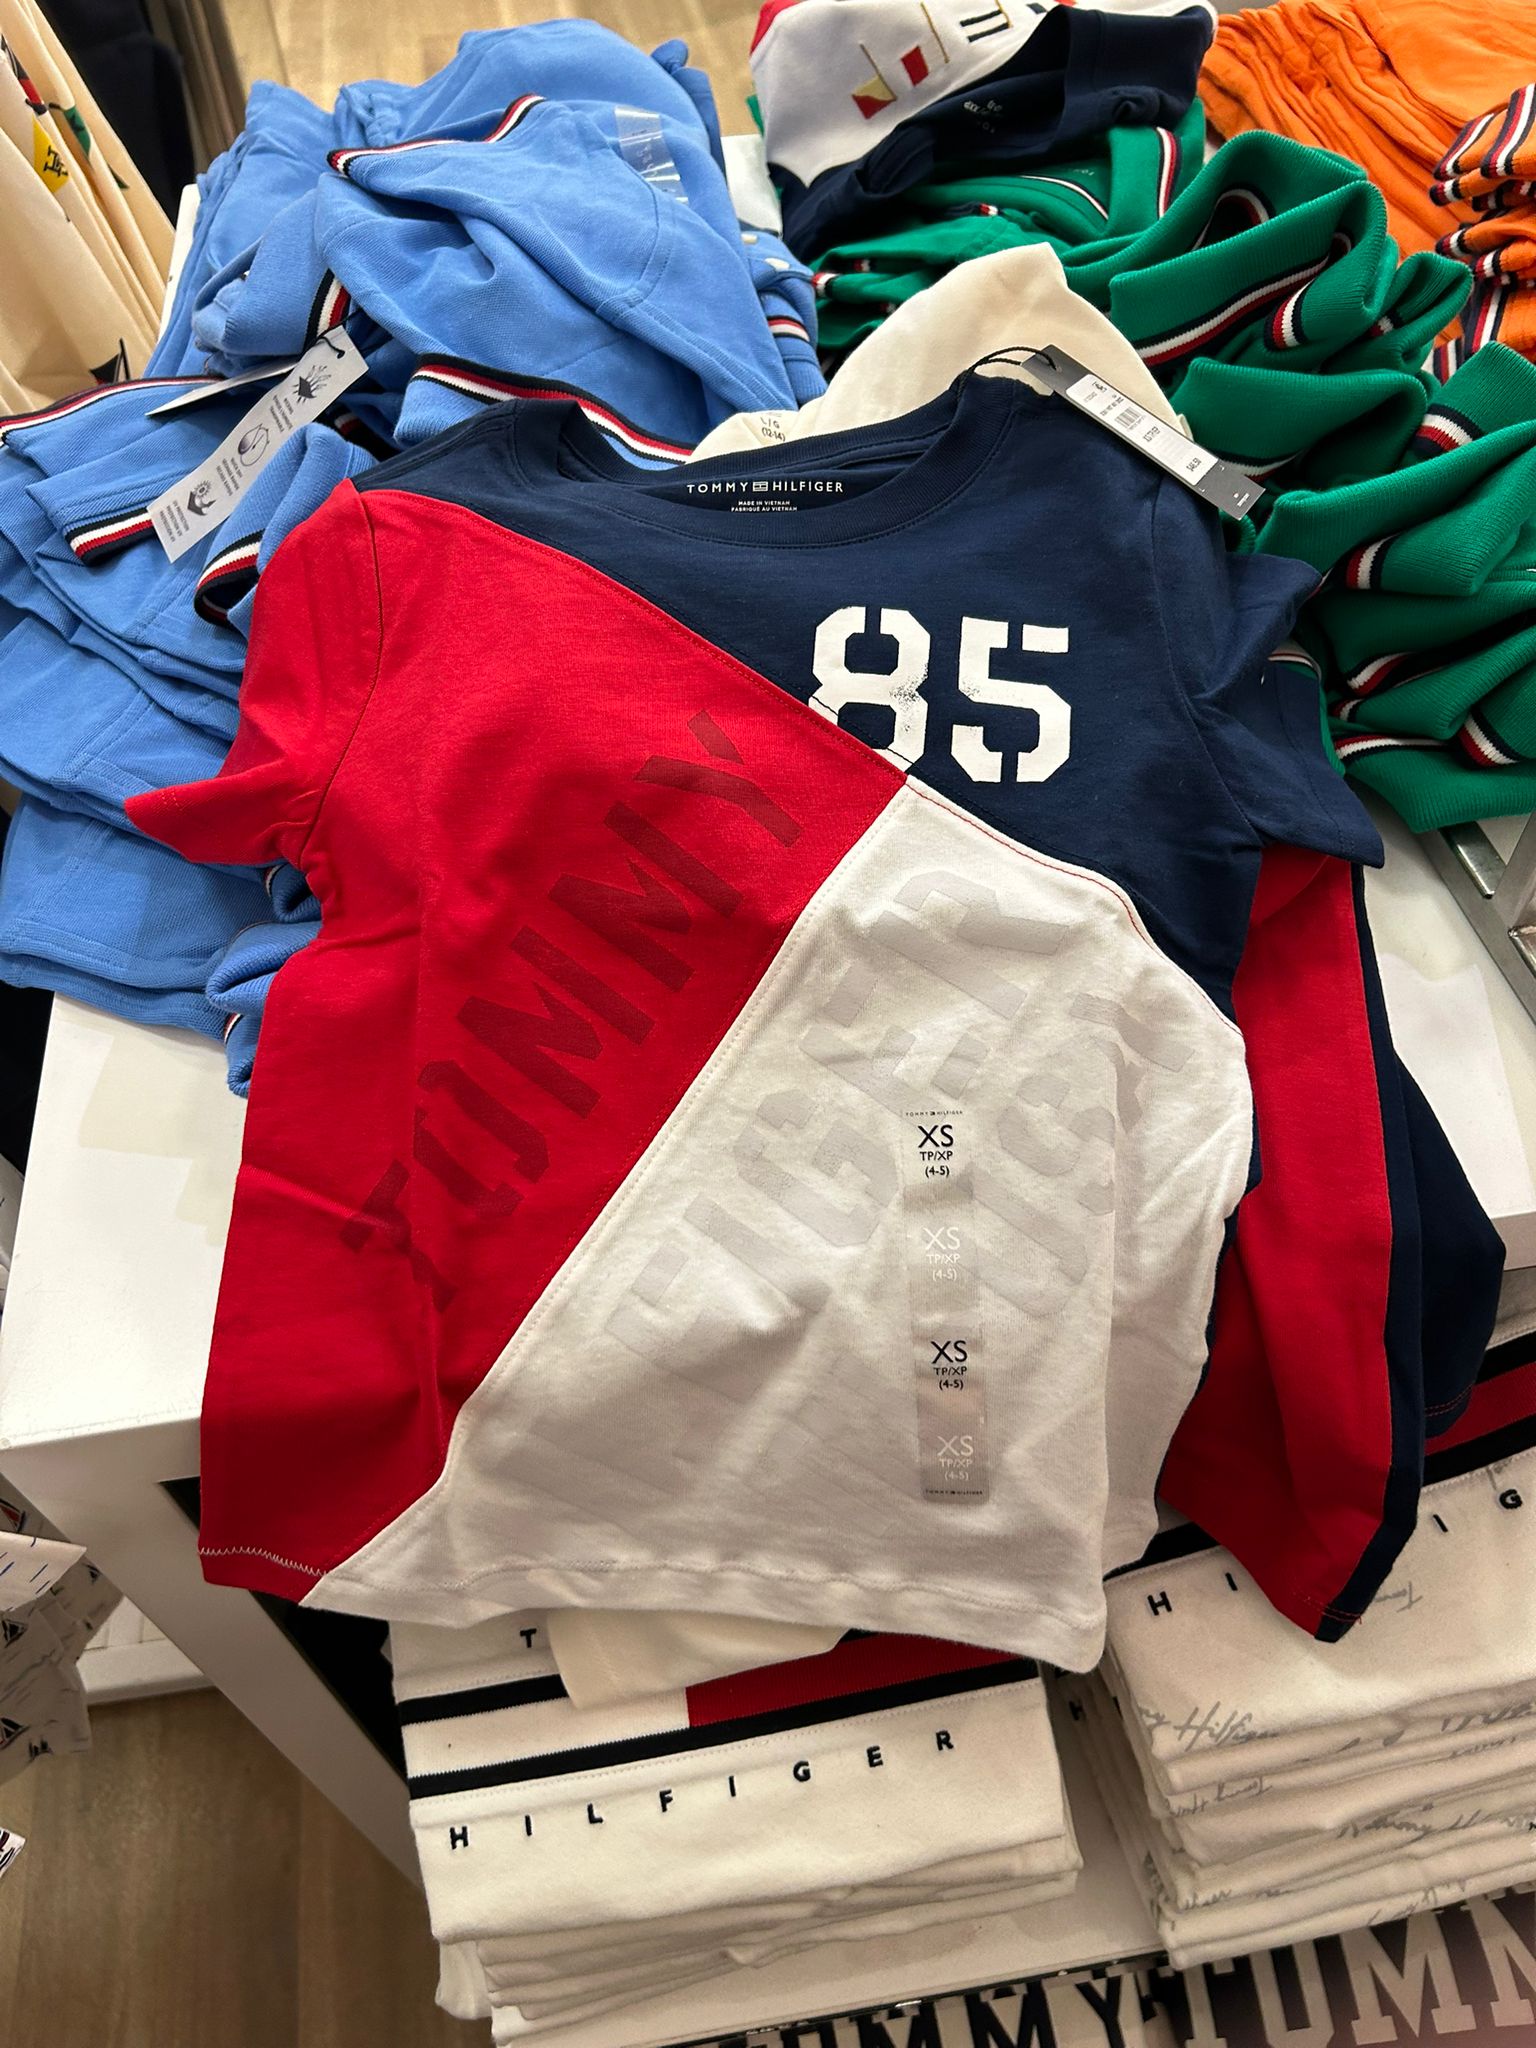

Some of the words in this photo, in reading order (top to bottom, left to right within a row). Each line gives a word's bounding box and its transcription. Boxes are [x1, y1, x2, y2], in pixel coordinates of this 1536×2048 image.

[686, 481, 749, 494] TOMMY
[772, 480, 844, 493] HILFIGER
[808, 606, 1071, 783] 85
[338, 709, 804, 1315] TOMMY
[917, 1125, 954, 1149] XS
[919, 1151, 954, 1162] TP/XP
[924, 1166, 950, 1179] (4-5)
[923, 1226, 961, 1251] XS
[926, 1253, 961, 1265] TP/XP
[932, 1268, 957, 1281] (4-5)
[930, 1340, 968, 1365] XS
[933, 1366, 968, 1377] TP/XP
[938, 1379, 964, 1391] (4-5)
[937, 1434, 974, 1457] XS
[939, 1458, 973, 1469] TP/XP
[944, 1471, 969, 1482] (4-5)
[449, 1729, 955, 1850] HILFIGER
